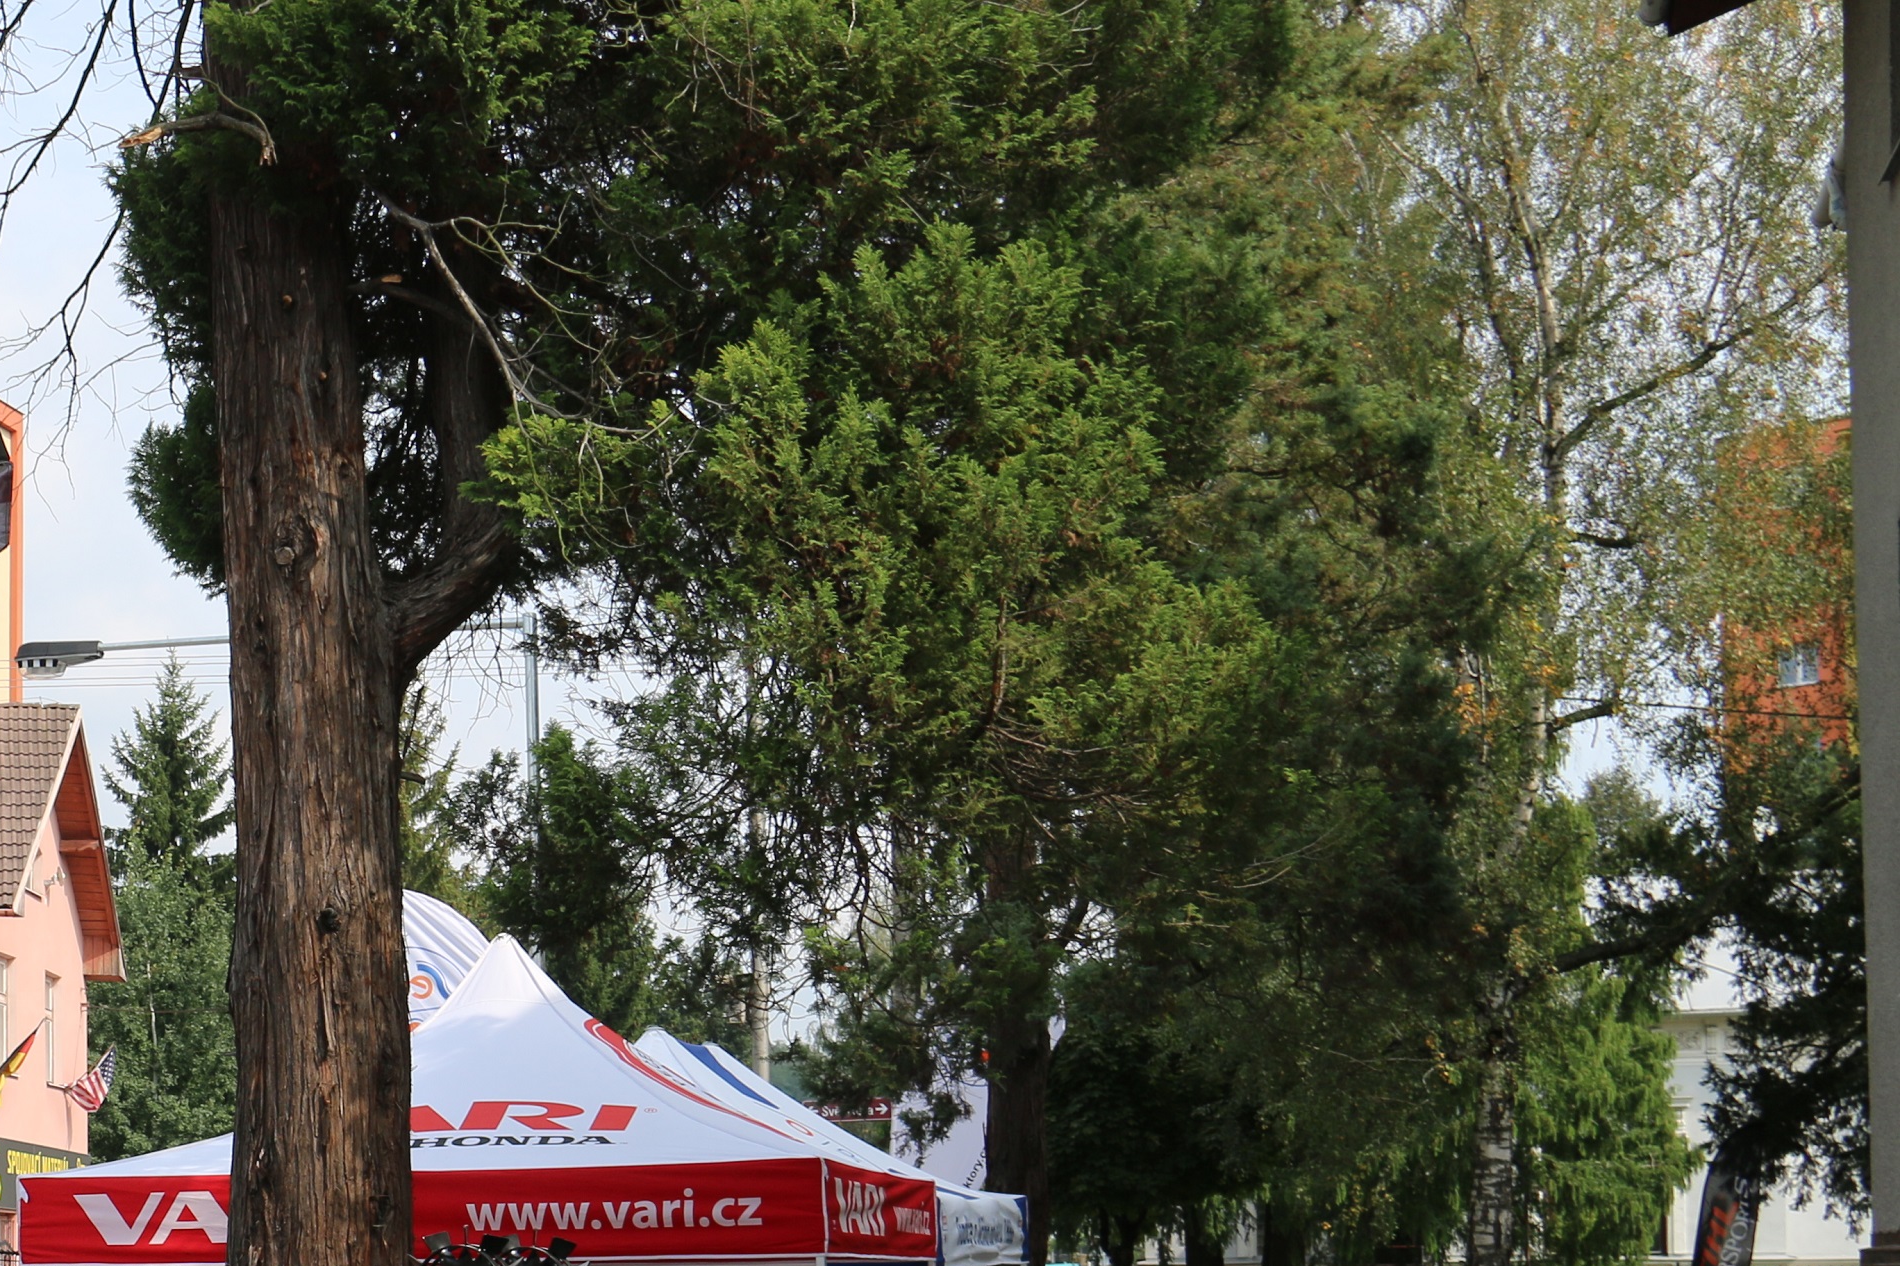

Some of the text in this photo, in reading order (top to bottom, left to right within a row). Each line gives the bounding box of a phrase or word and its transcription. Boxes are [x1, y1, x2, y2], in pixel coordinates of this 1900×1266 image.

[410, 1101, 638, 1133] RI
[411, 1135, 617, 1149] HONDA
[962, 1150, 988, 1190] ktory.c
[73, 1190, 230, 1246] VA
[466, 1188, 763, 1232] www.vari.cz
[834, 1176, 886, 1237] VARI
